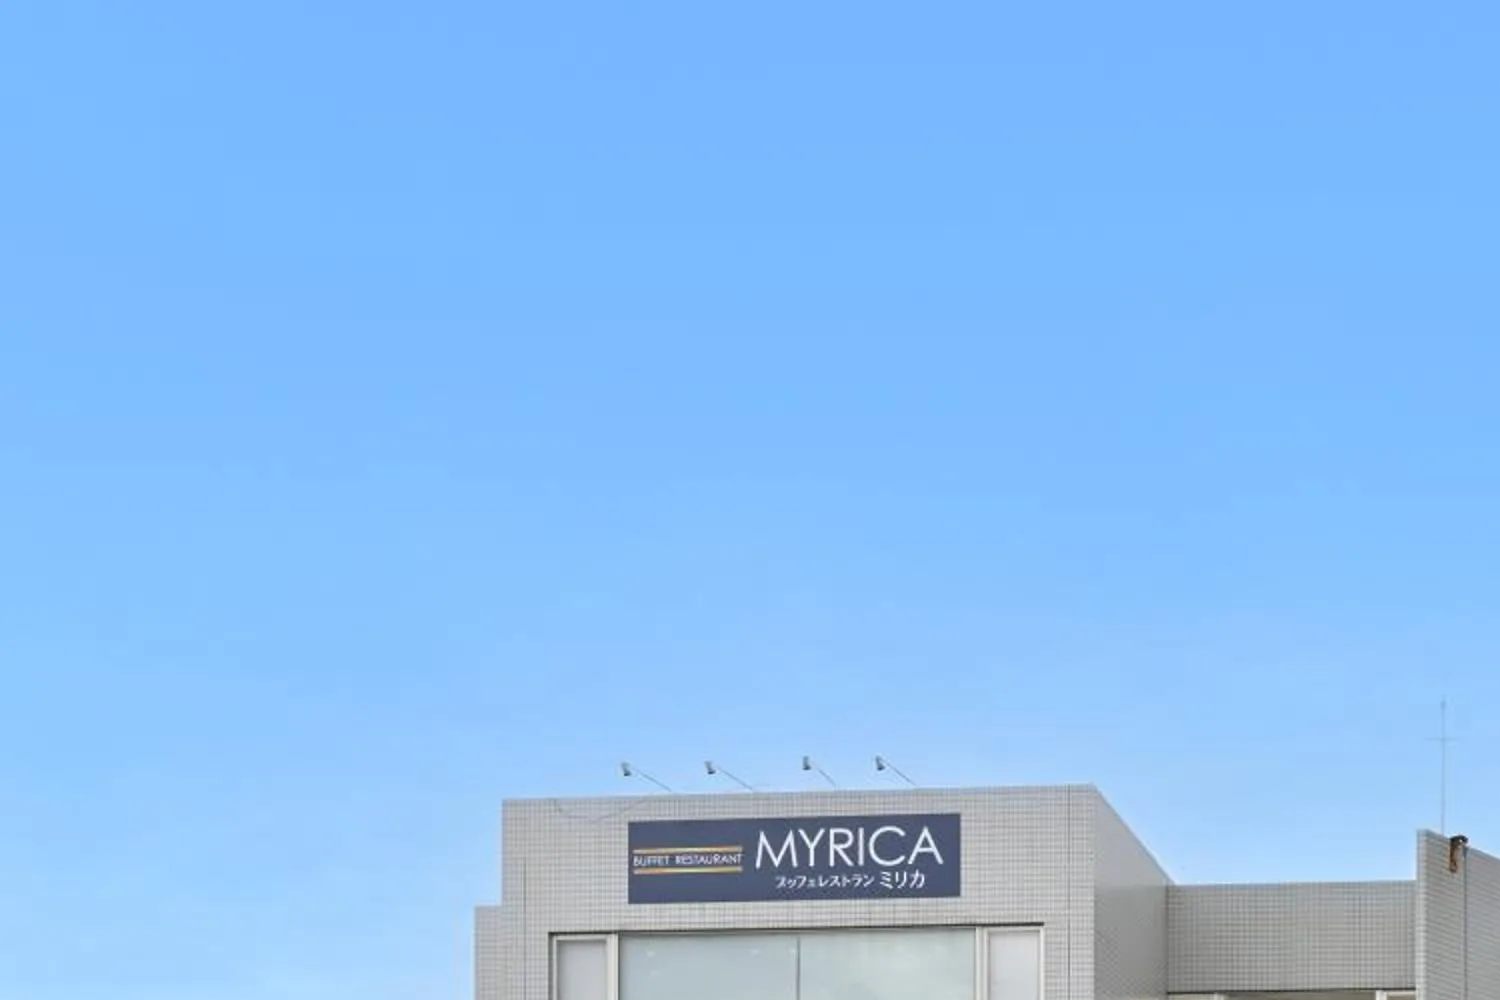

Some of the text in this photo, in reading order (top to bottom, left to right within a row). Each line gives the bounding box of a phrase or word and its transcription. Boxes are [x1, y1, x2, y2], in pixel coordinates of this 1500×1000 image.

[755, 825, 944, 869] MYRICA
[633, 853, 743, 867] BUFFET RESTAURANT
[879, 870, 926, 889] ミリカ
